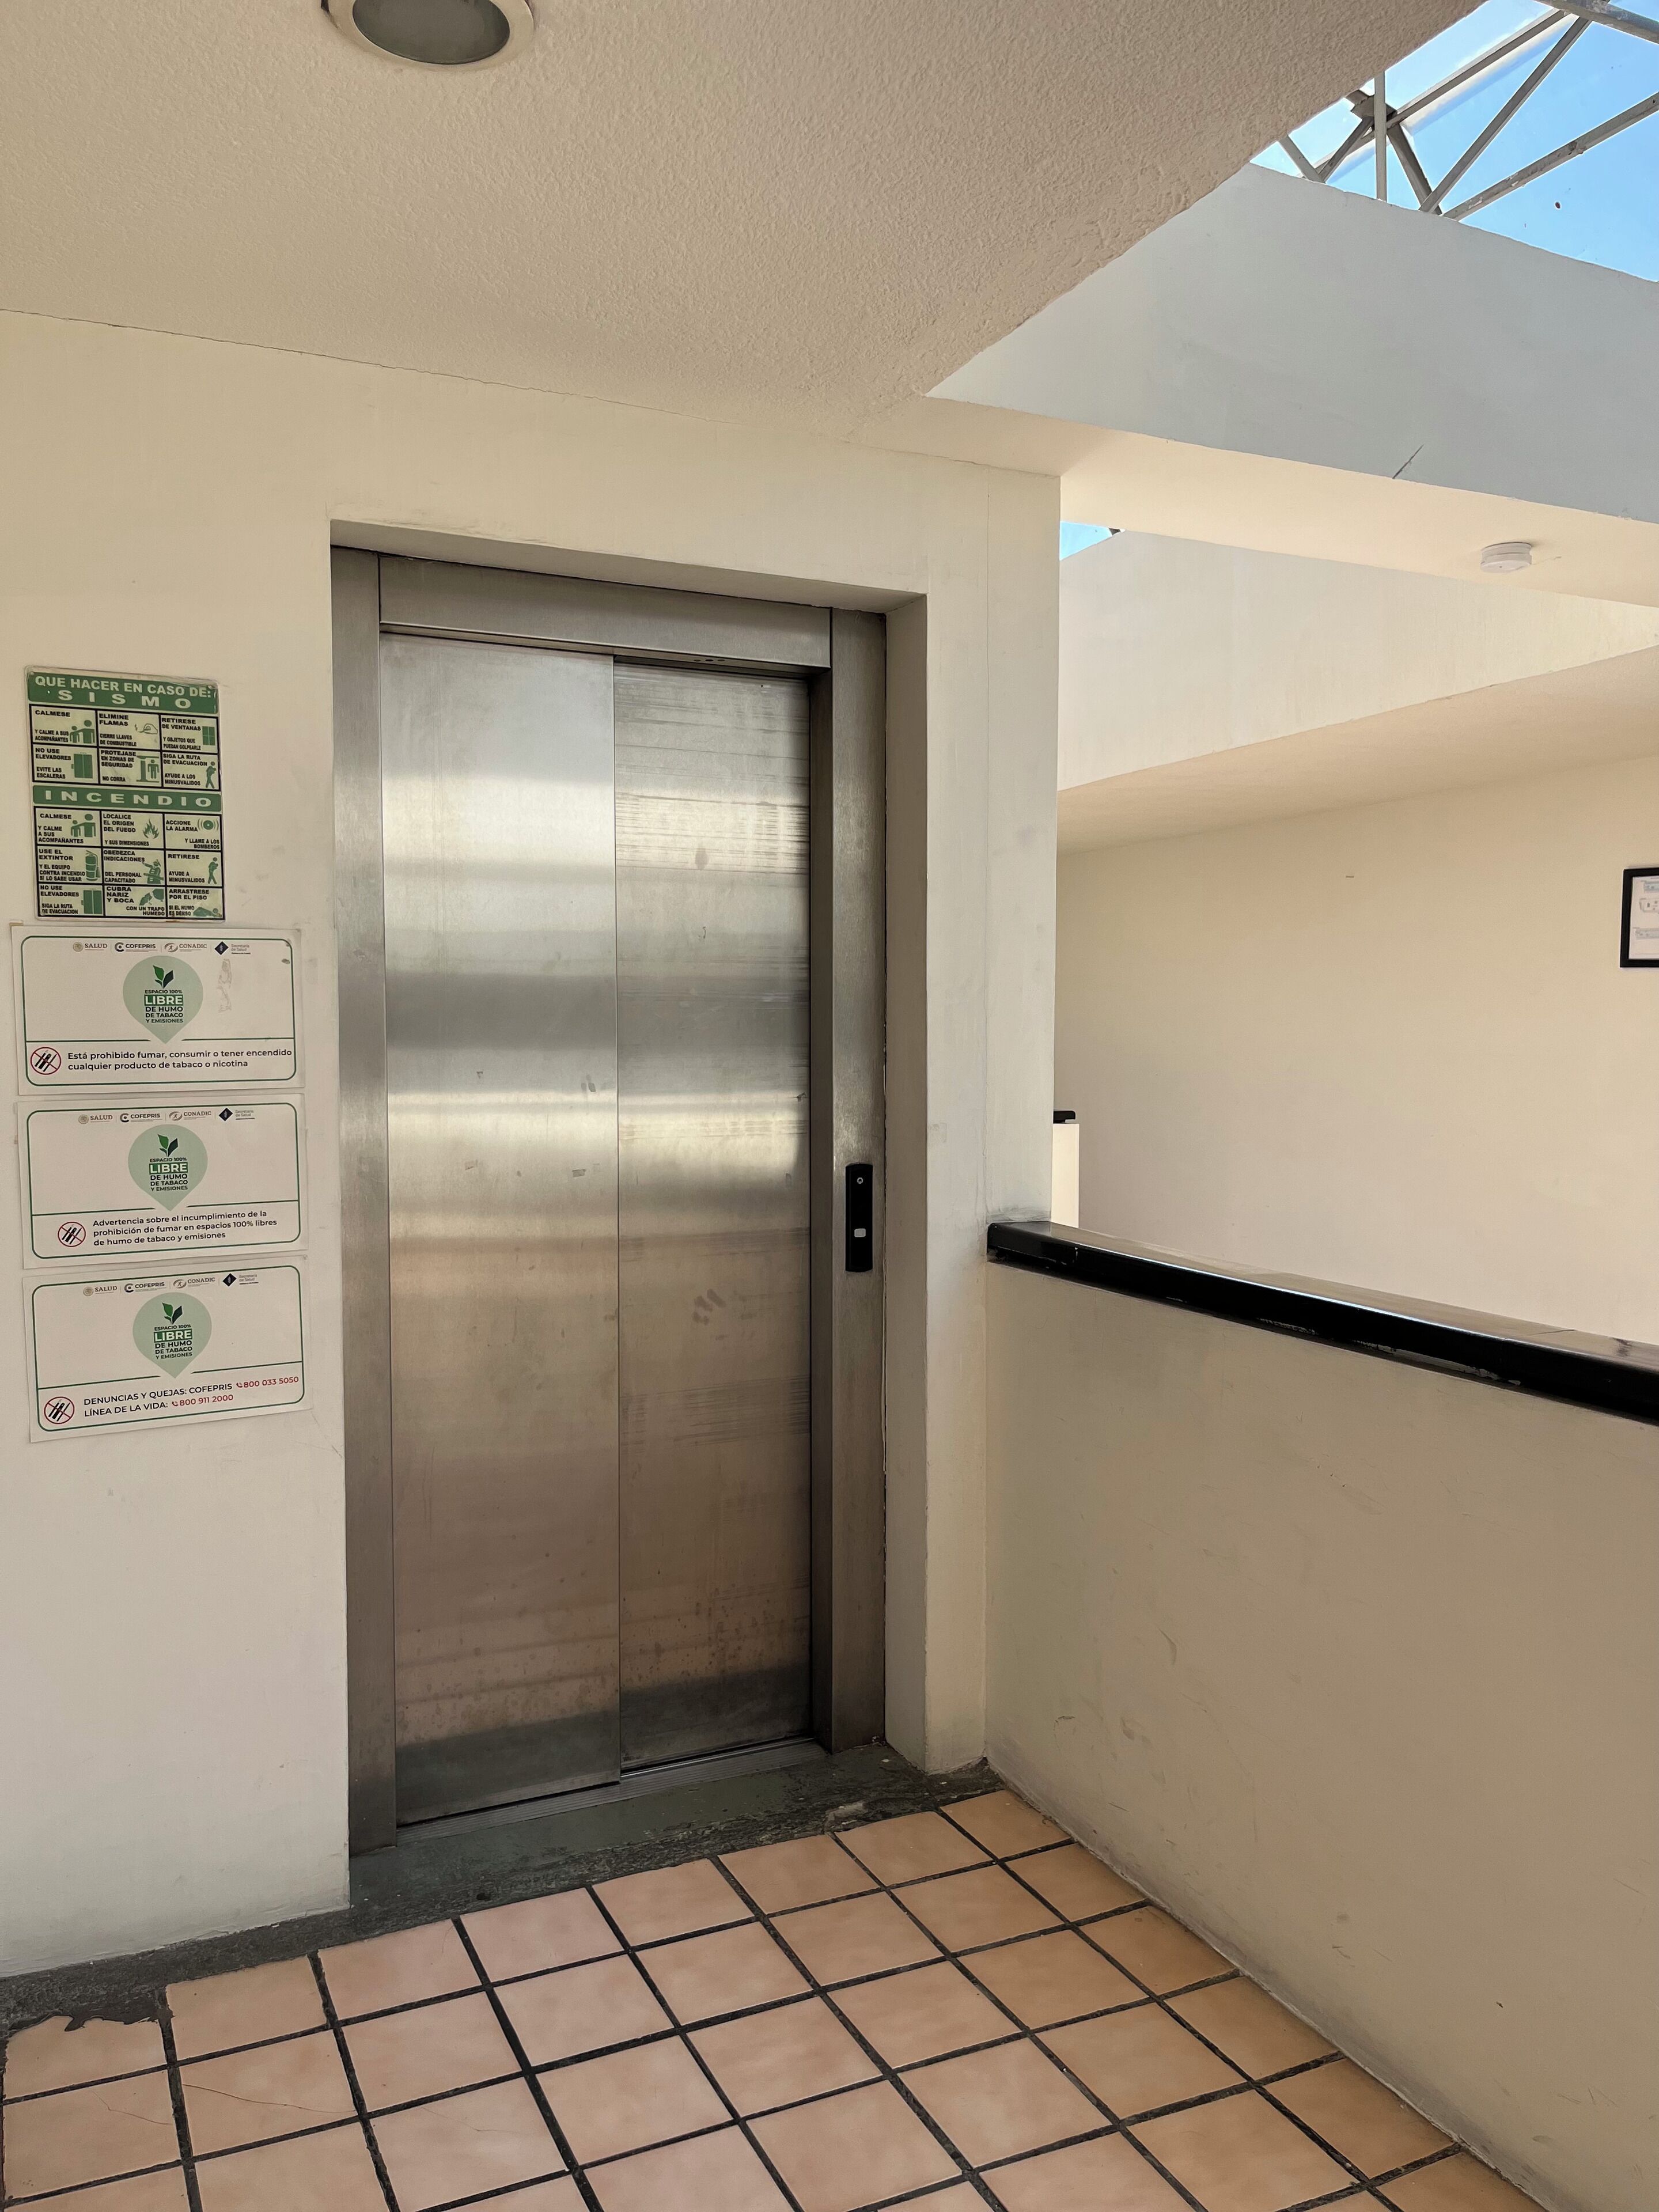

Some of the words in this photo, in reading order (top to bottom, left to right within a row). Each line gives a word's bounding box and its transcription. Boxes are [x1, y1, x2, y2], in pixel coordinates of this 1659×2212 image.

[35, 676, 66, 687] QUE
[71, 679, 119, 691] HACER
[124, 683, 142, 693] EN
[147, 684, 184, 696] CASO
[190, 687, 211, 698] DE:
[58, 690, 191, 709] SISMO
[46, 790, 211, 806] INCENDIO
[146, 995, 183, 1005] LIBRE
[90, 1051, 135, 1060] prohibido
[68, 1062, 112, 1071] cualquier
[115, 1062, 156, 1071] producto
[150, 1164, 187, 1173] LIBRE
[93, 1218, 143, 1226] Advertencia
[181, 1211, 245, 1222] incumplimiento
[93, 1227, 142, 1237] prohibición
[196, 1222, 231, 1231] espacios
[184, 1232, 226, 1240] emisiones
[155, 1330, 192, 1341] LIBRE
[84, 1393, 139, 1406] DENUNCIAS
[149, 1388, 187, 1399] QUEJAS:
[189, 1383, 232, 1394] COFEPRIS
[279, 1376, 299, 1384] 5050
[85, 1406, 112, 1416] LÍNEA
[115, 1406, 127, 1414] DE
[143, 1402, 168, 1410] VIDA:
[180, 1398, 196, 1406] 800
[212, 1394, 233, 1403] 2000
